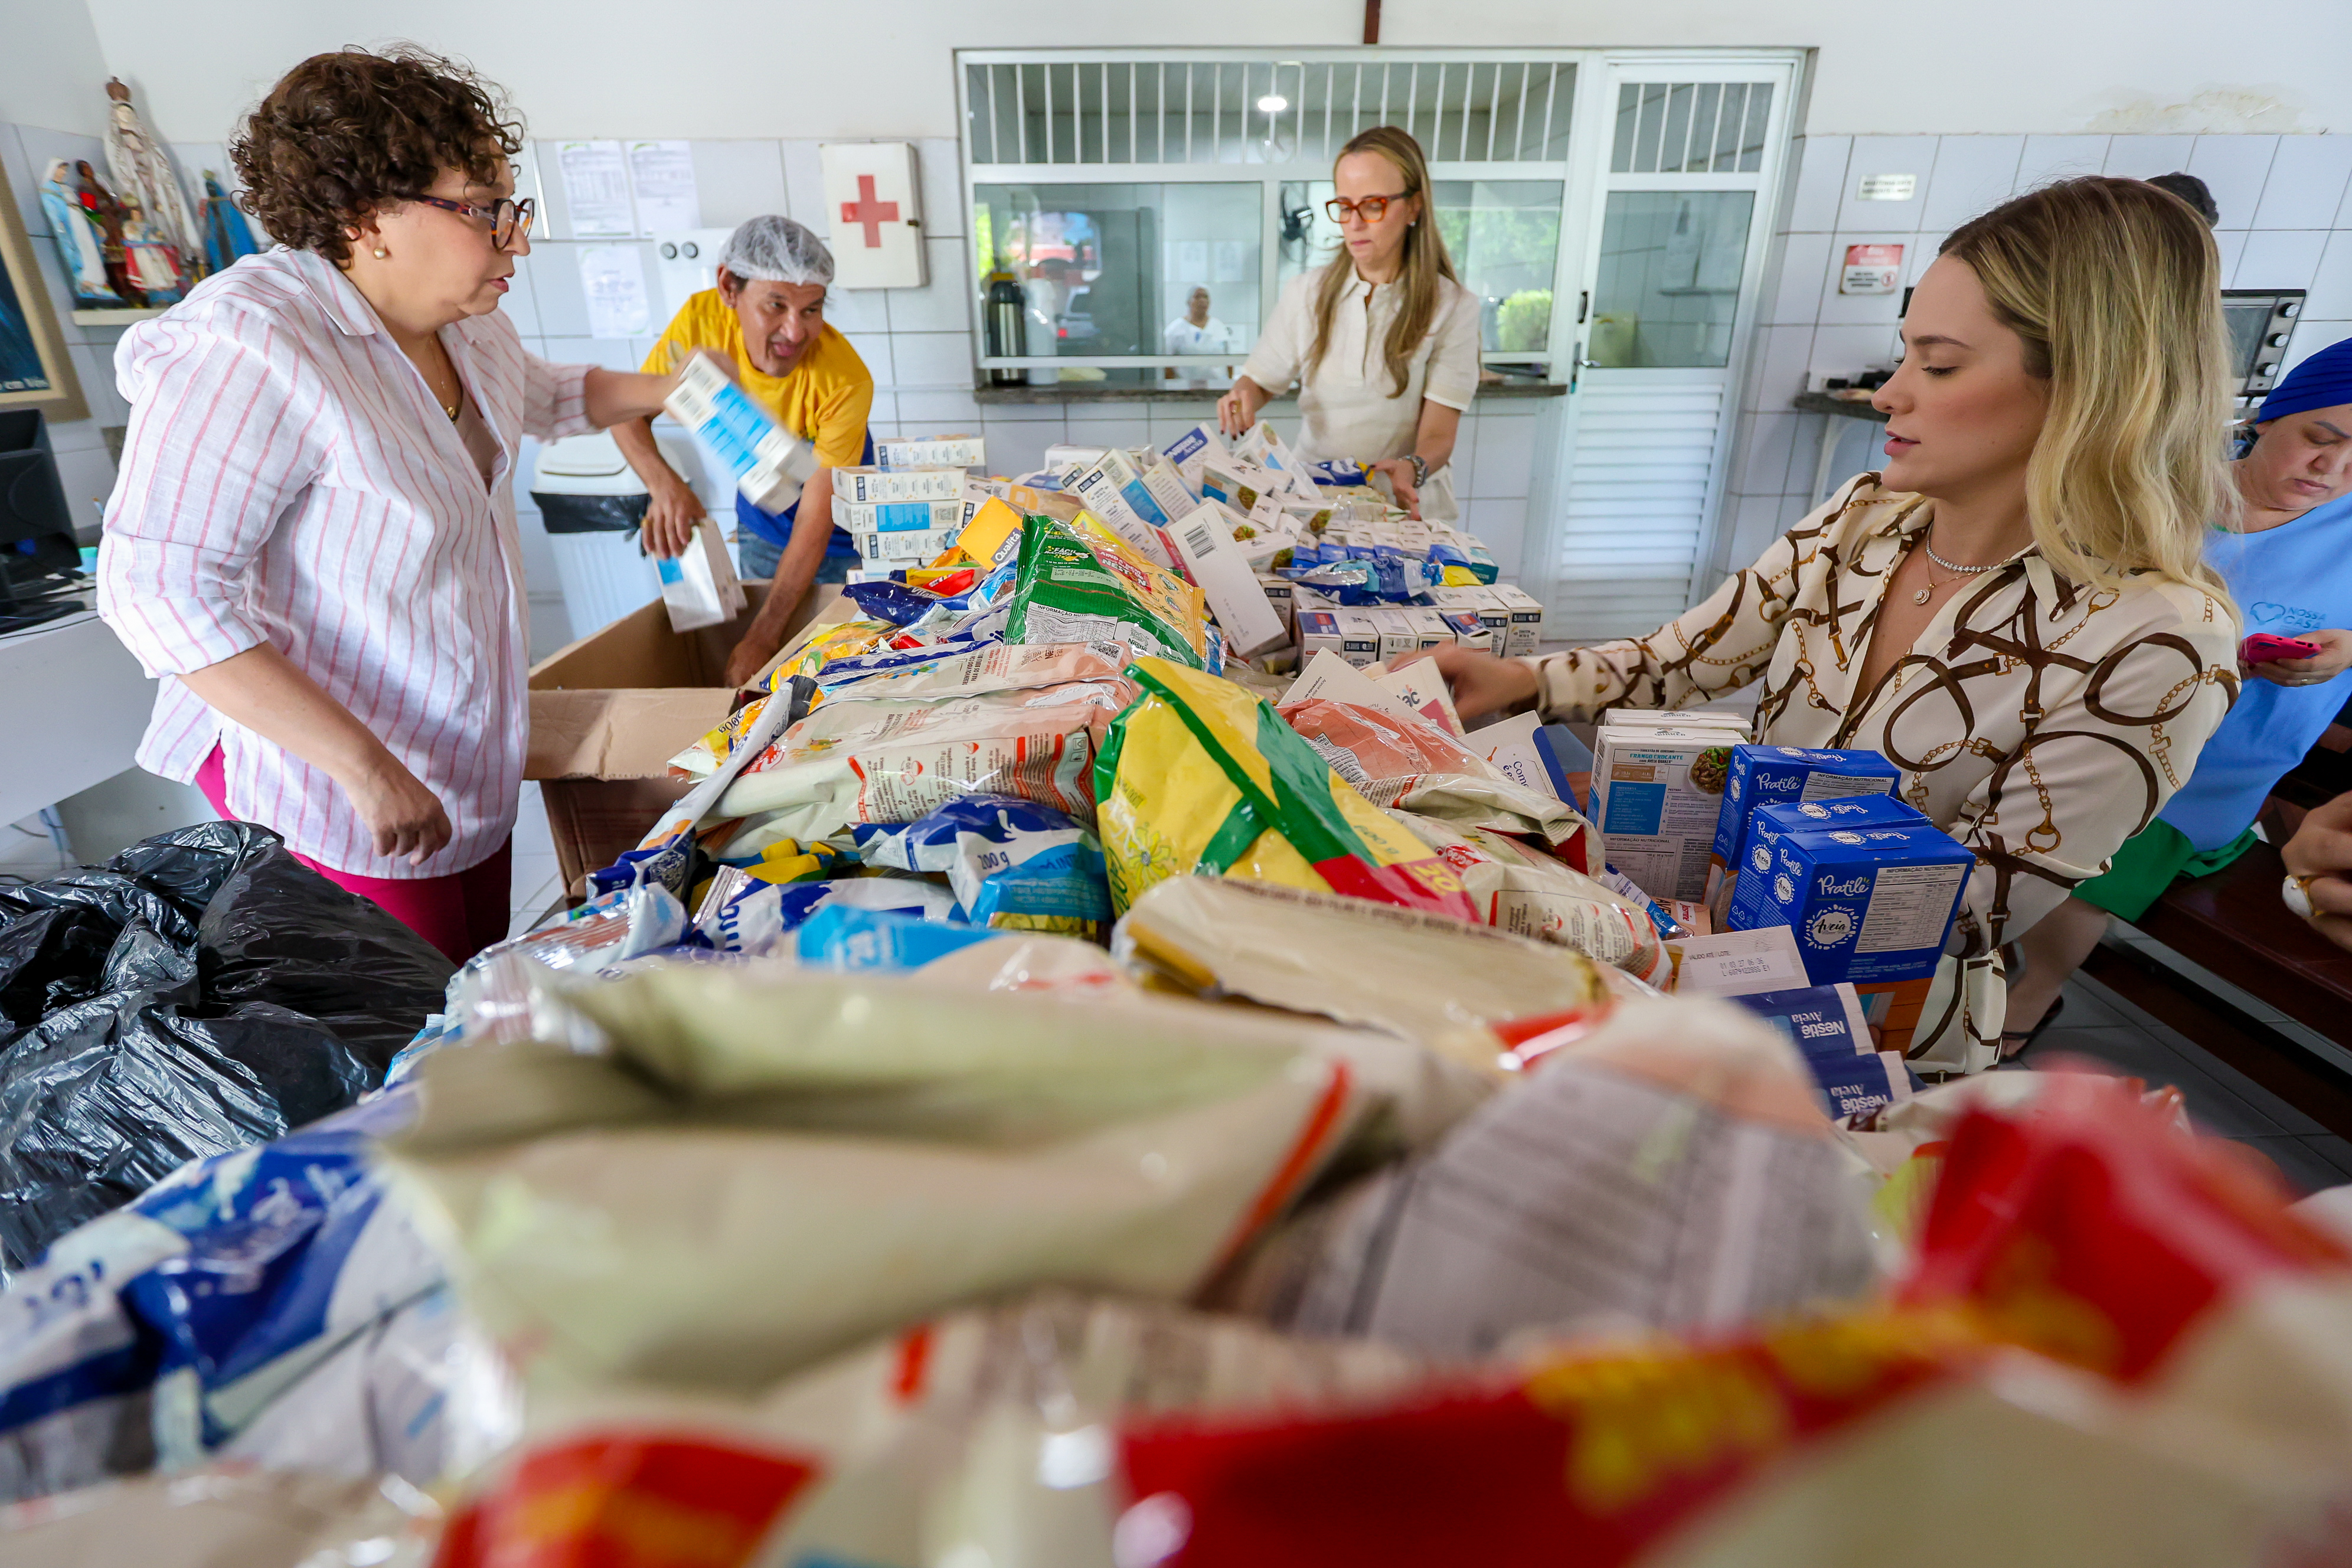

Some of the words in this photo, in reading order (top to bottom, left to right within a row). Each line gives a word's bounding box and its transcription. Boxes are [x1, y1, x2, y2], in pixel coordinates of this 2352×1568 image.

[995, 531, 1021, 561] Qualitá
[1100, 551, 1123, 564] AINDA
[1037, 605, 1072, 616] INFORMAÇÃO
[2288, 607, 2326, 620] NOSSA
[2284, 615, 2321, 629] CASA
[1128, 638, 1148, 652] Nestlé
[961, 661, 974, 686] DESENVOLVIDO
[971, 672, 979, 682] PARA
[1304, 675, 1323, 700] surpreenda-se!
[1757, 821, 1779, 845] Pratil
[999, 851, 1010, 865] g
[1755, 850, 1769, 865] Aveia
[1656, 898, 1671, 916] AVE
[1680, 903, 1691, 922] Jasmine
[1814, 919, 1847, 934] Aveia
[1791, 1011, 1822, 1024] Aveia
[1801, 1021, 1846, 1039] Nestlé
[1830, 1084, 1864, 1099] Aveia
[1841, 1094, 1889, 1115] Nestlé
